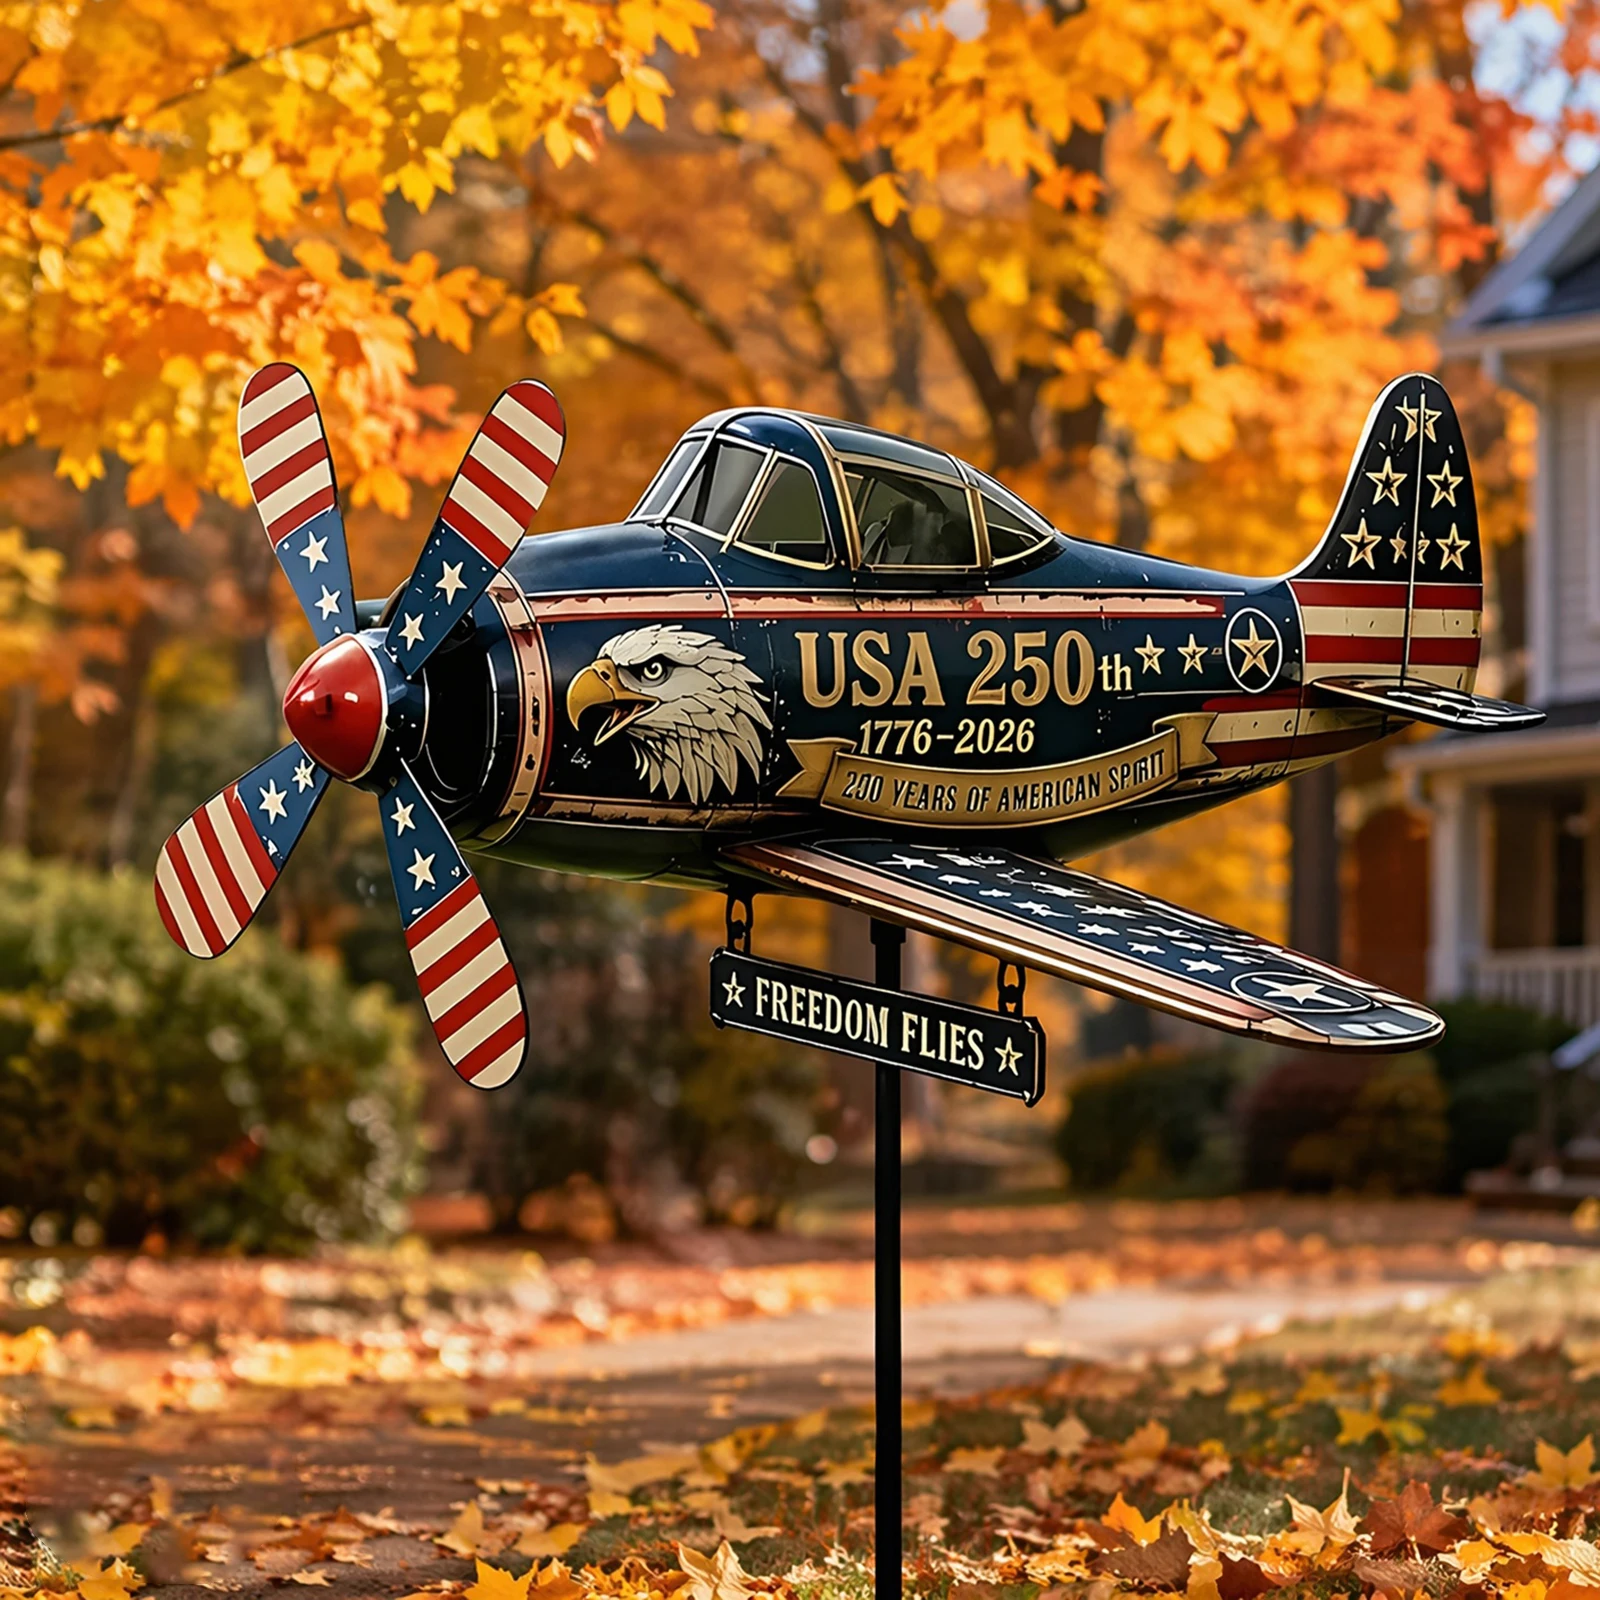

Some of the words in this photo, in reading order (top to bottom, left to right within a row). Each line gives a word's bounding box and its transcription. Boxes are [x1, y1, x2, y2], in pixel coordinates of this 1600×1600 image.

[794, 630, 946, 708] USA
[893, 778, 957, 812] YEARS
[965, 785, 992, 813] OF
[997, 771, 1101, 814] AMERICAN
[755, 975, 890, 1048] FREEDOM
[901, 1010, 985, 1071] FLIES
